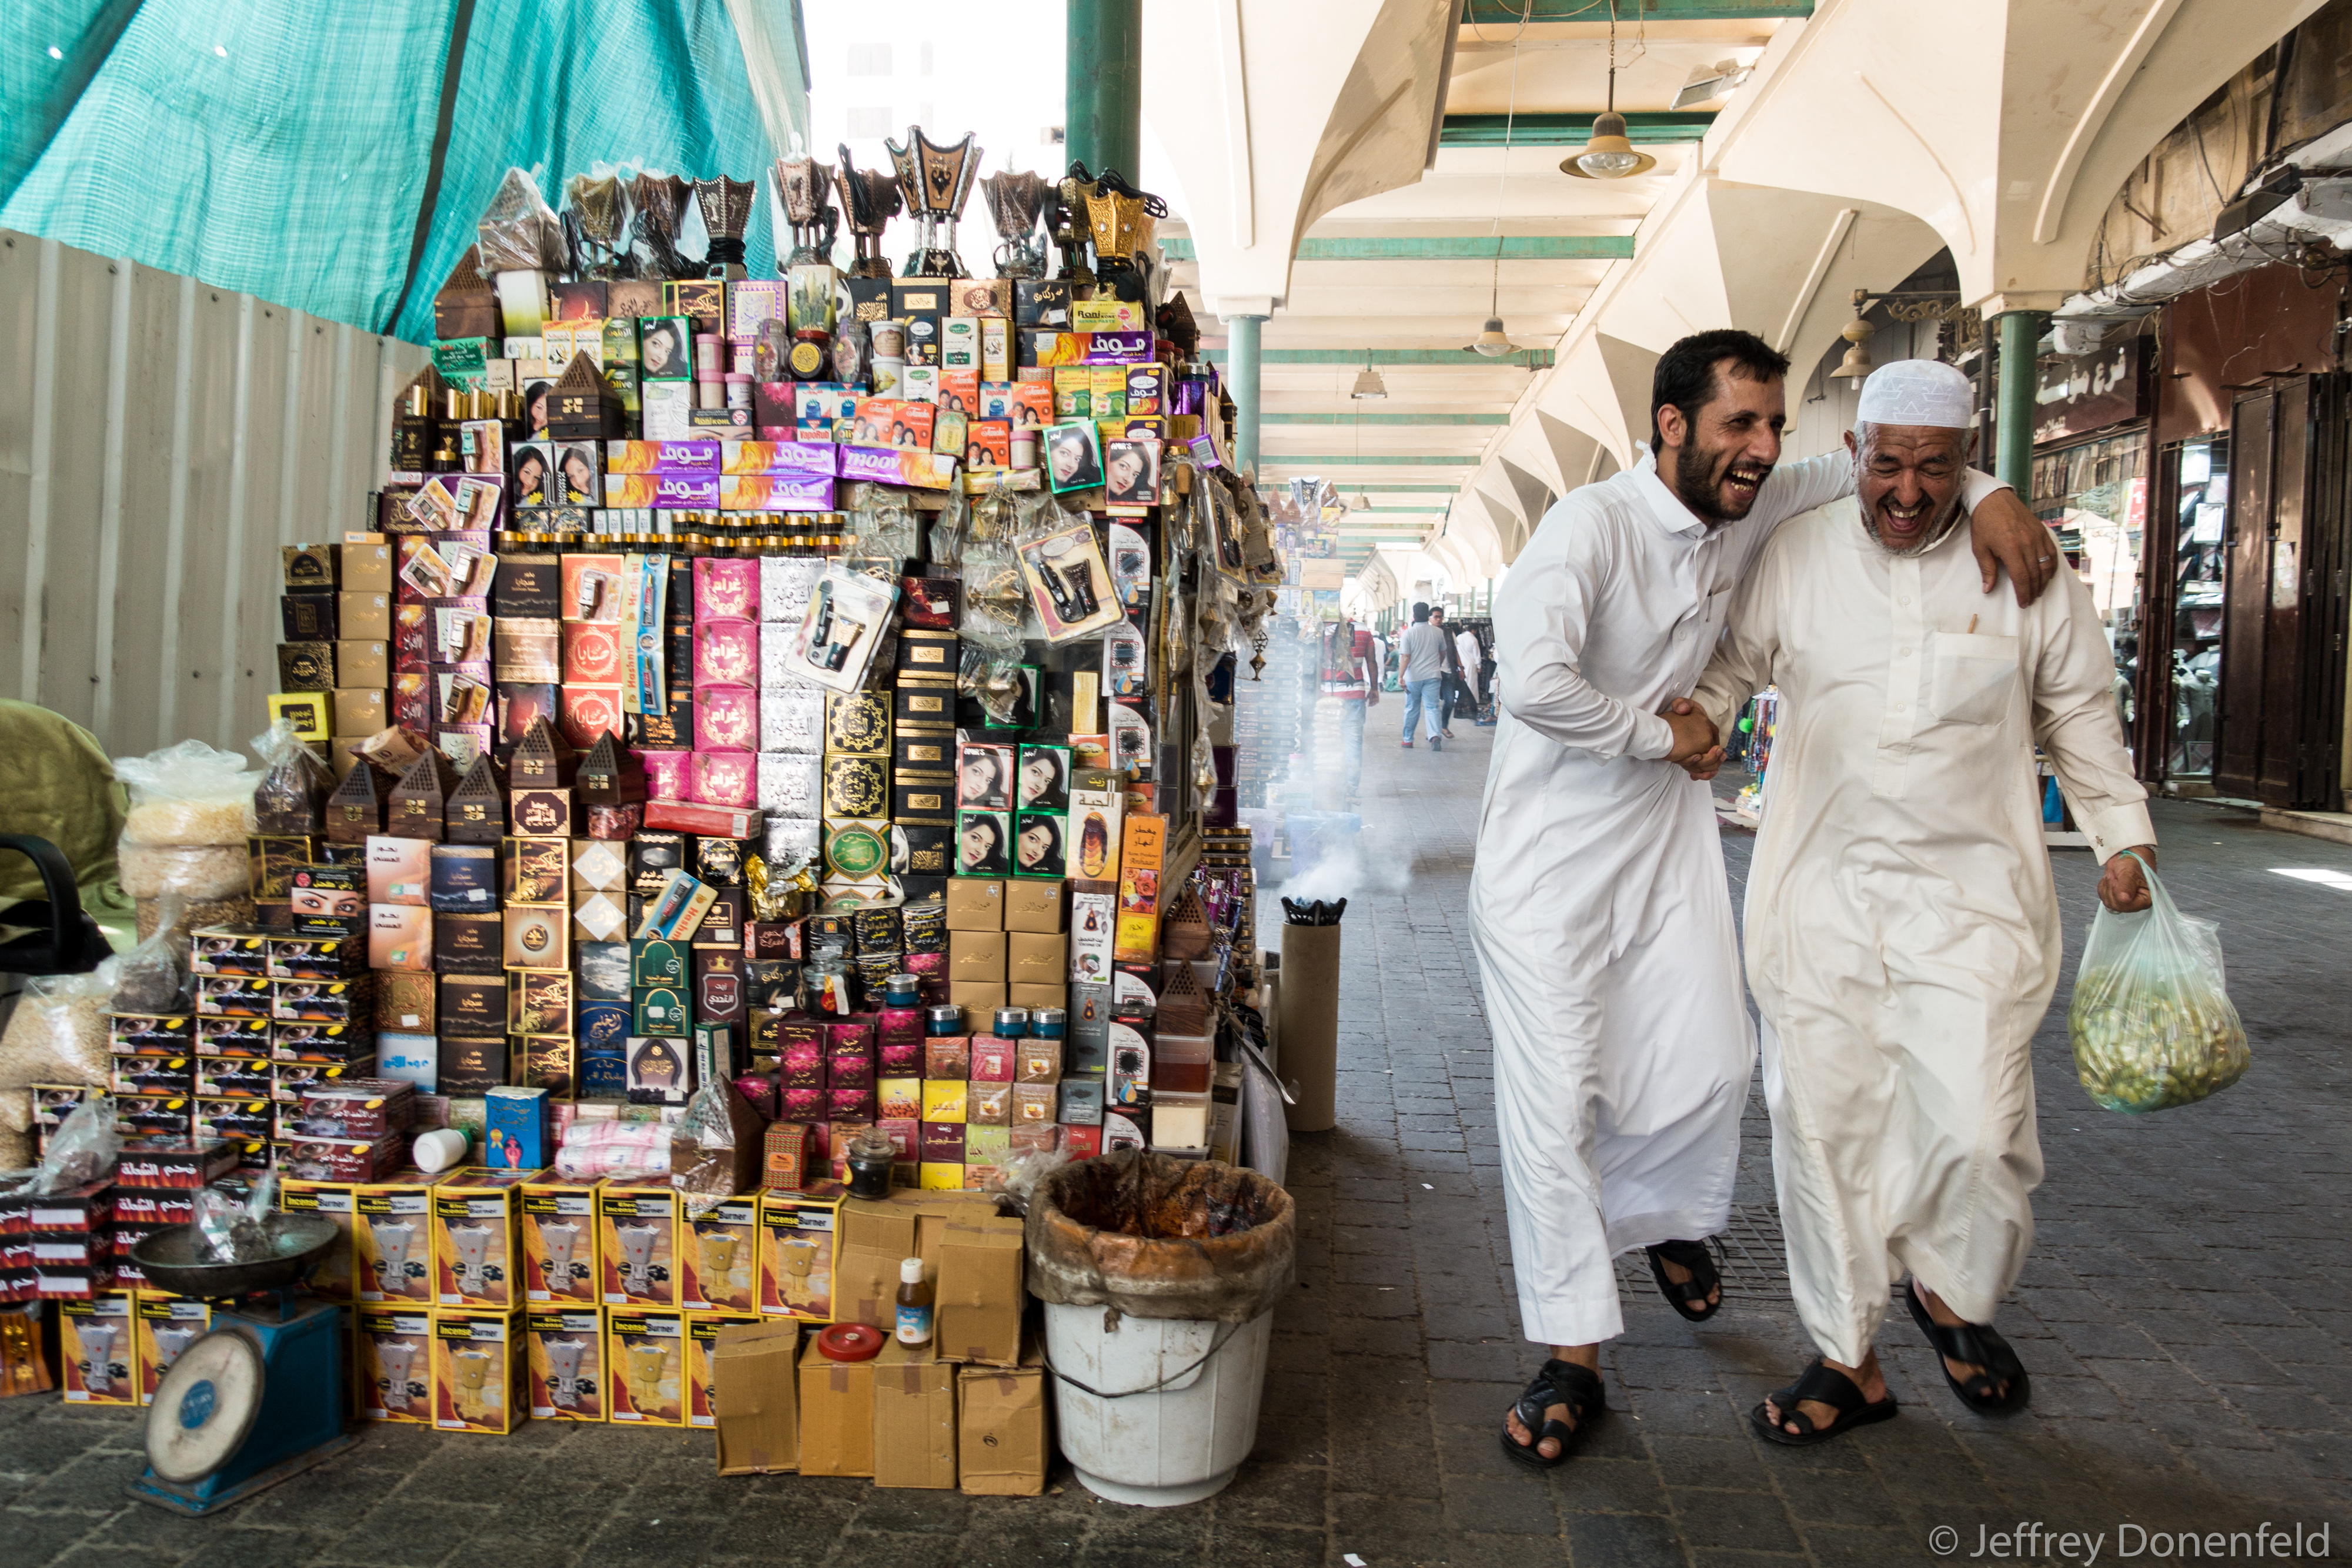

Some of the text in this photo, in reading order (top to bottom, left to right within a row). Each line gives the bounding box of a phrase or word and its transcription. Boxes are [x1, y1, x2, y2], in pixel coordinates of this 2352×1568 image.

[1078, 310, 1100, 319] Rani
[1088, 335, 1146, 356] موف
[2092, 347, 2127, 395] فرع
[610, 380, 633, 389] Olive
[1130, 388, 1157, 397] موف
[799, 430, 830, 440] VapoRub
[658, 444, 713, 464] موف
[773, 446, 829, 465] موف
[846, 452, 902, 470] moov
[656, 478, 712, 499] موف
[770, 479, 827, 499] موف
[627, 562, 640, 607] Hashmi
[711, 579, 743, 595] غرام
[709, 645, 741, 661] غرام
[627, 646, 639, 690] Hashmi
[710, 708, 740, 724] غرام
[709, 772, 739, 788] غرام
[1088, 777, 1105, 787] زيت
[1135, 825, 1157, 835] معطر
[671, 906, 700, 940] Hashm
[1071, 1130, 1087, 1139] زيت
[287, 1197, 346, 1209] Incense Burner
[360, 1203, 392, 1211] Incense
[527, 1203, 584, 1212] Incense Burner
[439, 1206, 469, 1215] Incense
[604, 1205, 665, 1215] Incense Burner
[718, 1210, 747, 1221] Burner
[765, 1214, 827, 1228] Incense Burner
[395, 1322, 422, 1331] Burner
[532, 1320, 563, 1329] Incense
[614, 1322, 675, 1334] Incense Burner
[440, 1325, 498, 1338] Incense Burner
